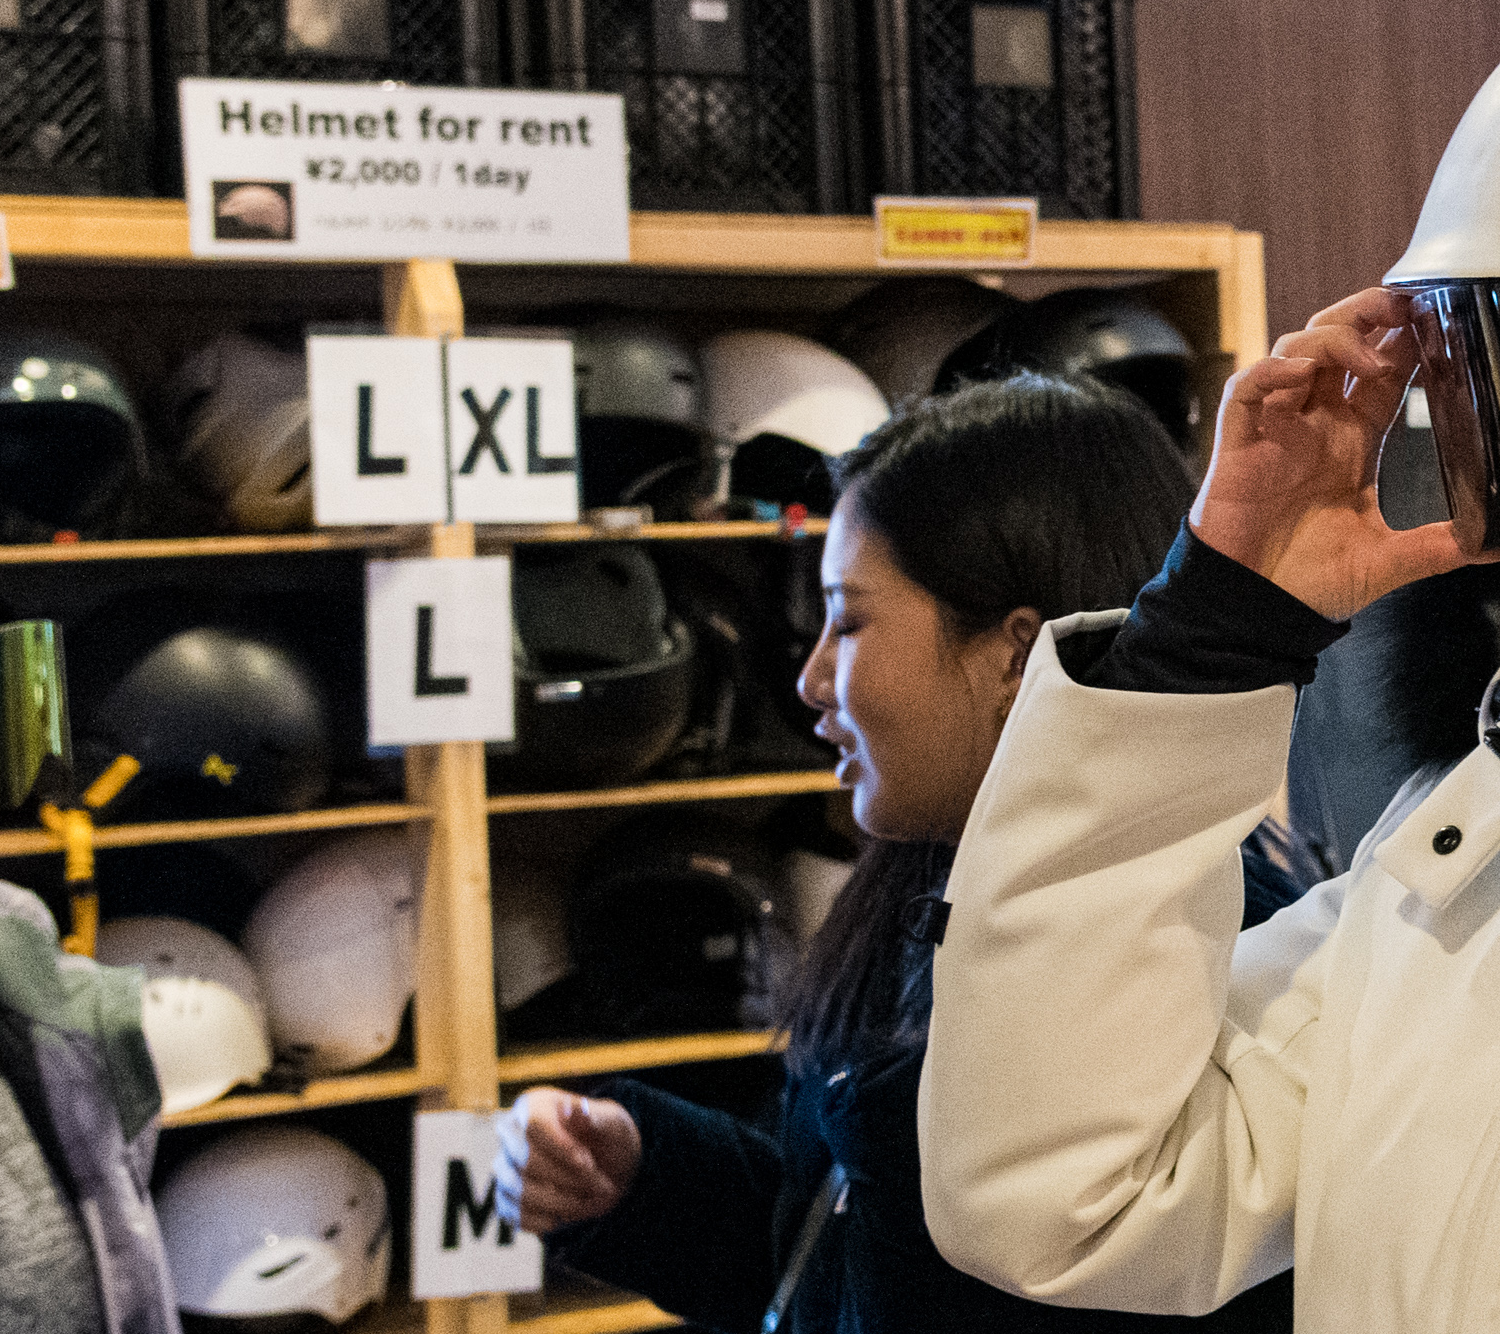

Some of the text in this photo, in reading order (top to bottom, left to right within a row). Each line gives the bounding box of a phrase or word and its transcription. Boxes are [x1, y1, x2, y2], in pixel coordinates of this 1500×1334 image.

[218, 98, 593, 148] Helmet for rent
[305, 158, 421, 189] ¥2,000
[454, 162, 532, 196] 1day
[356, 384, 409, 477] L
[458, 386, 577, 477] XL
[413, 604, 470, 697] L
[441, 1157, 516, 1250] M
